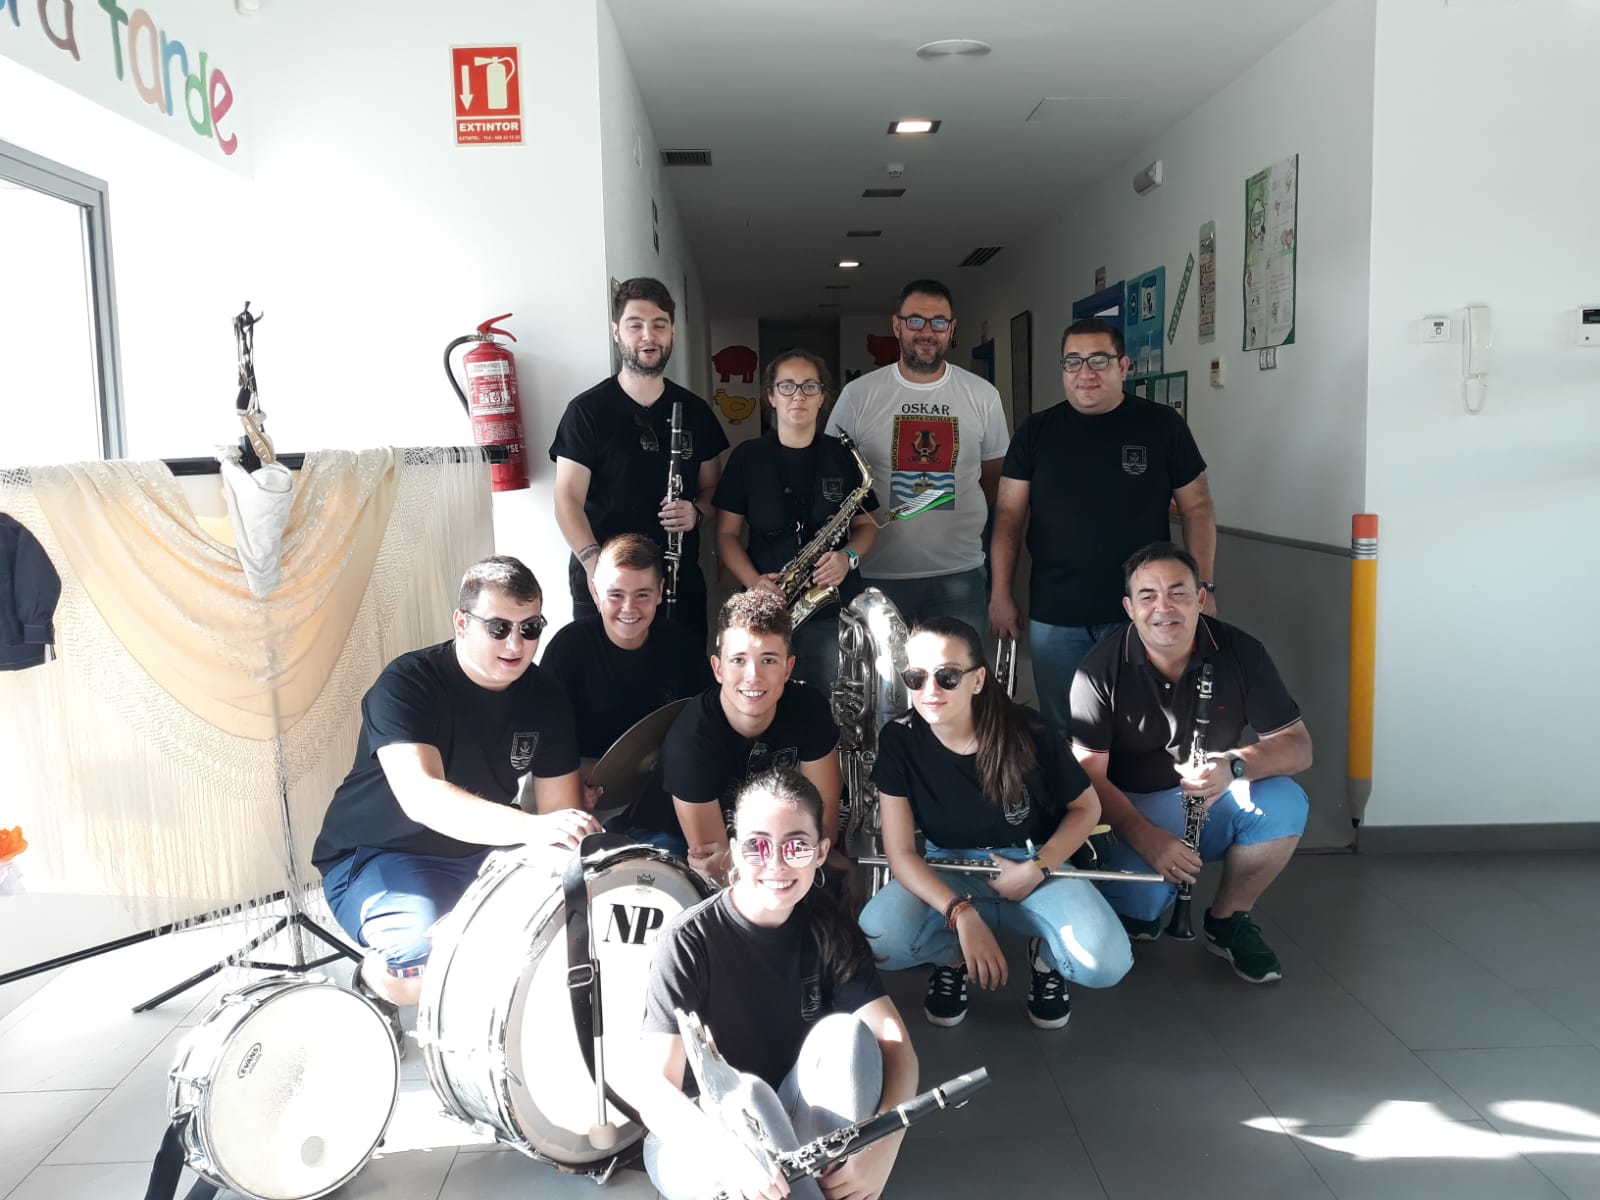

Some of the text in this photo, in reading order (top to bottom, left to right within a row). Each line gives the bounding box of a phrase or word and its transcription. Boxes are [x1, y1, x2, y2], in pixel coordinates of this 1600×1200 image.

[97, 0, 238, 155] tarde
[459, 121, 519, 132] EXTINTOR
[901, 403, 950, 416] OSKAR
[602, 903, 664, 945] NP
[240, 1047, 259, 1075] EVANS
